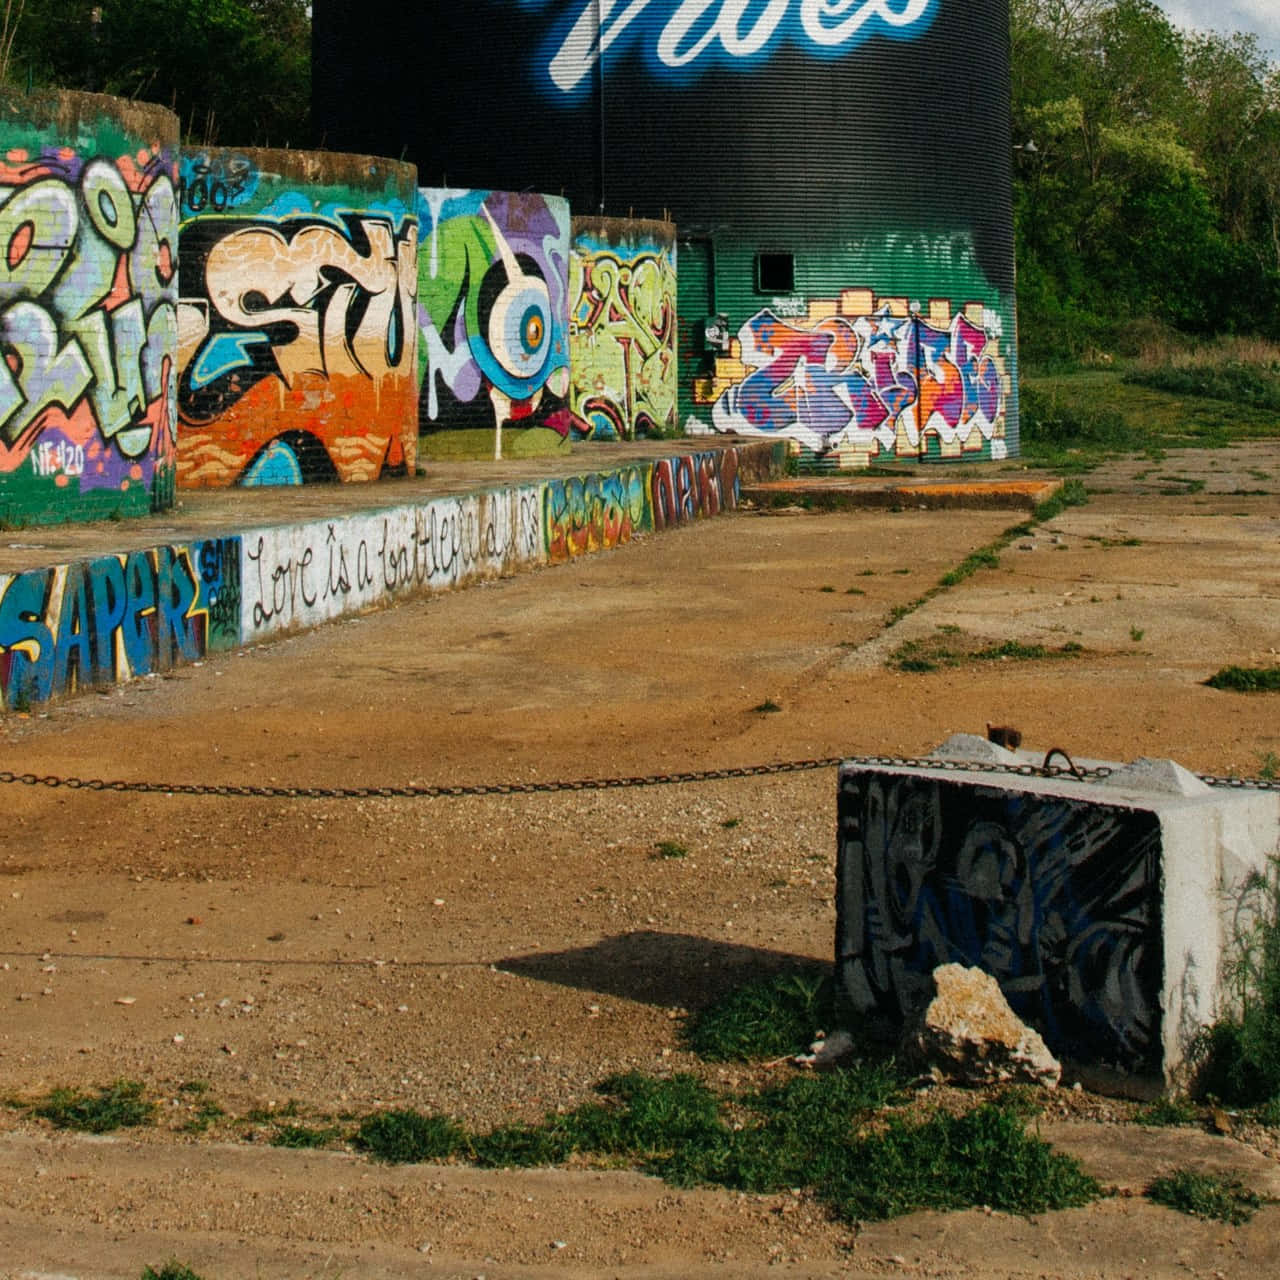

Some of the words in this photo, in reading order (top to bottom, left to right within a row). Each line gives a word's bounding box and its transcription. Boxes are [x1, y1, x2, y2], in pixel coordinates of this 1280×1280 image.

[247, 535, 318, 628] Love
[323, 524, 352, 598] is
[357, 540, 373, 590] a
